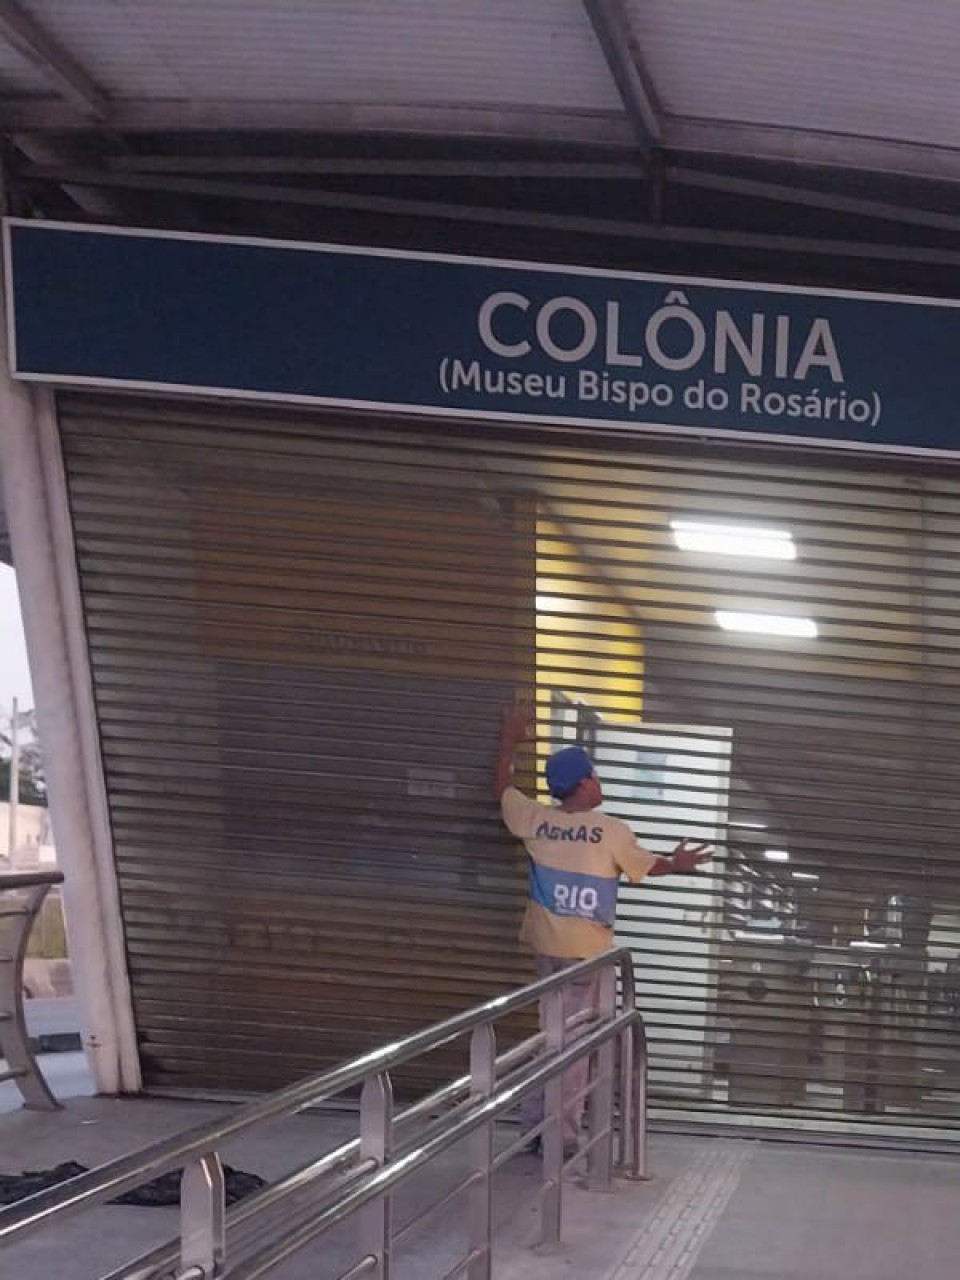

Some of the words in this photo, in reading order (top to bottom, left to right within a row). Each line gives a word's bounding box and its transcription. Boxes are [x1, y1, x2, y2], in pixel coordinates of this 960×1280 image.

[478, 290, 844, 383] COLÔNIA
[439, 357, 566, 398] (Museu
[578, 369, 673, 412] Bispo
[684, 380, 730, 410] do
[741, 383, 881, 427] Rosário)
[554, 884, 598, 910] RIO
